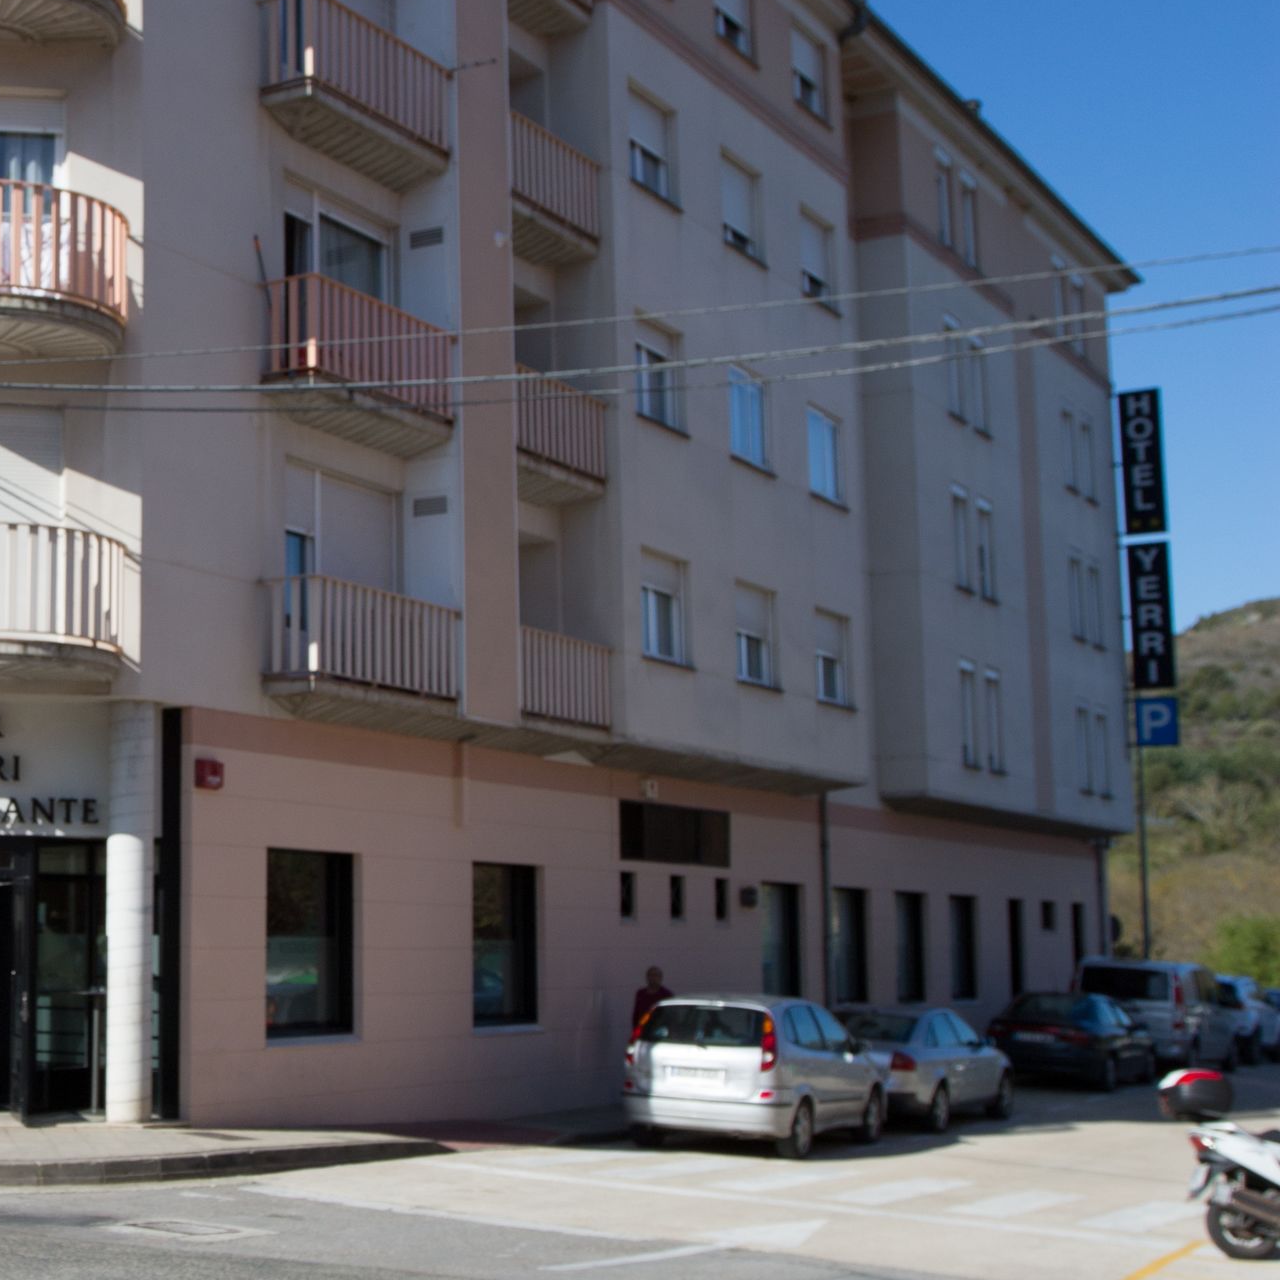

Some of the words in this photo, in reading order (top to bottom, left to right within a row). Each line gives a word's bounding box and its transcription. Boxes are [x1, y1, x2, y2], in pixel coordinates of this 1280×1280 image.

[1126, 394, 1156, 511] HOTEL
[1136, 549, 1165, 684] YERRI
[1142, 703, 1172, 741] P
